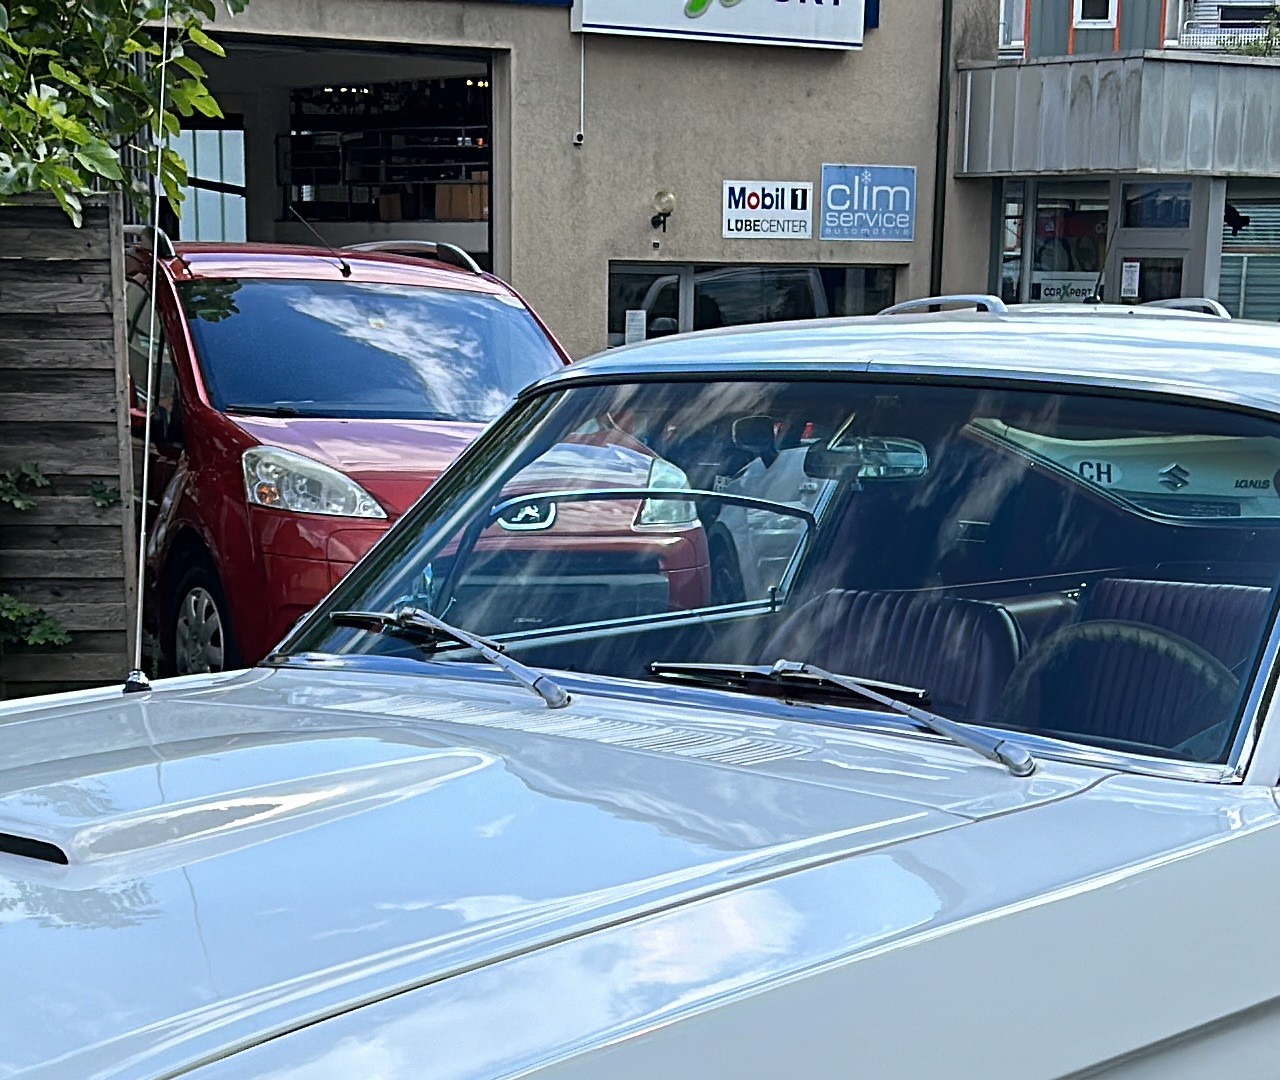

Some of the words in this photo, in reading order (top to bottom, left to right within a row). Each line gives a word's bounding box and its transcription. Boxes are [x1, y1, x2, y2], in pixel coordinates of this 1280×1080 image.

[728, 187, 785, 210] Mobil
[827, 175, 910, 211] clim
[825, 210, 910, 227] service
[1078, 461, 1112, 483] CH
[1235, 479, 1270, 489] IGNIS
